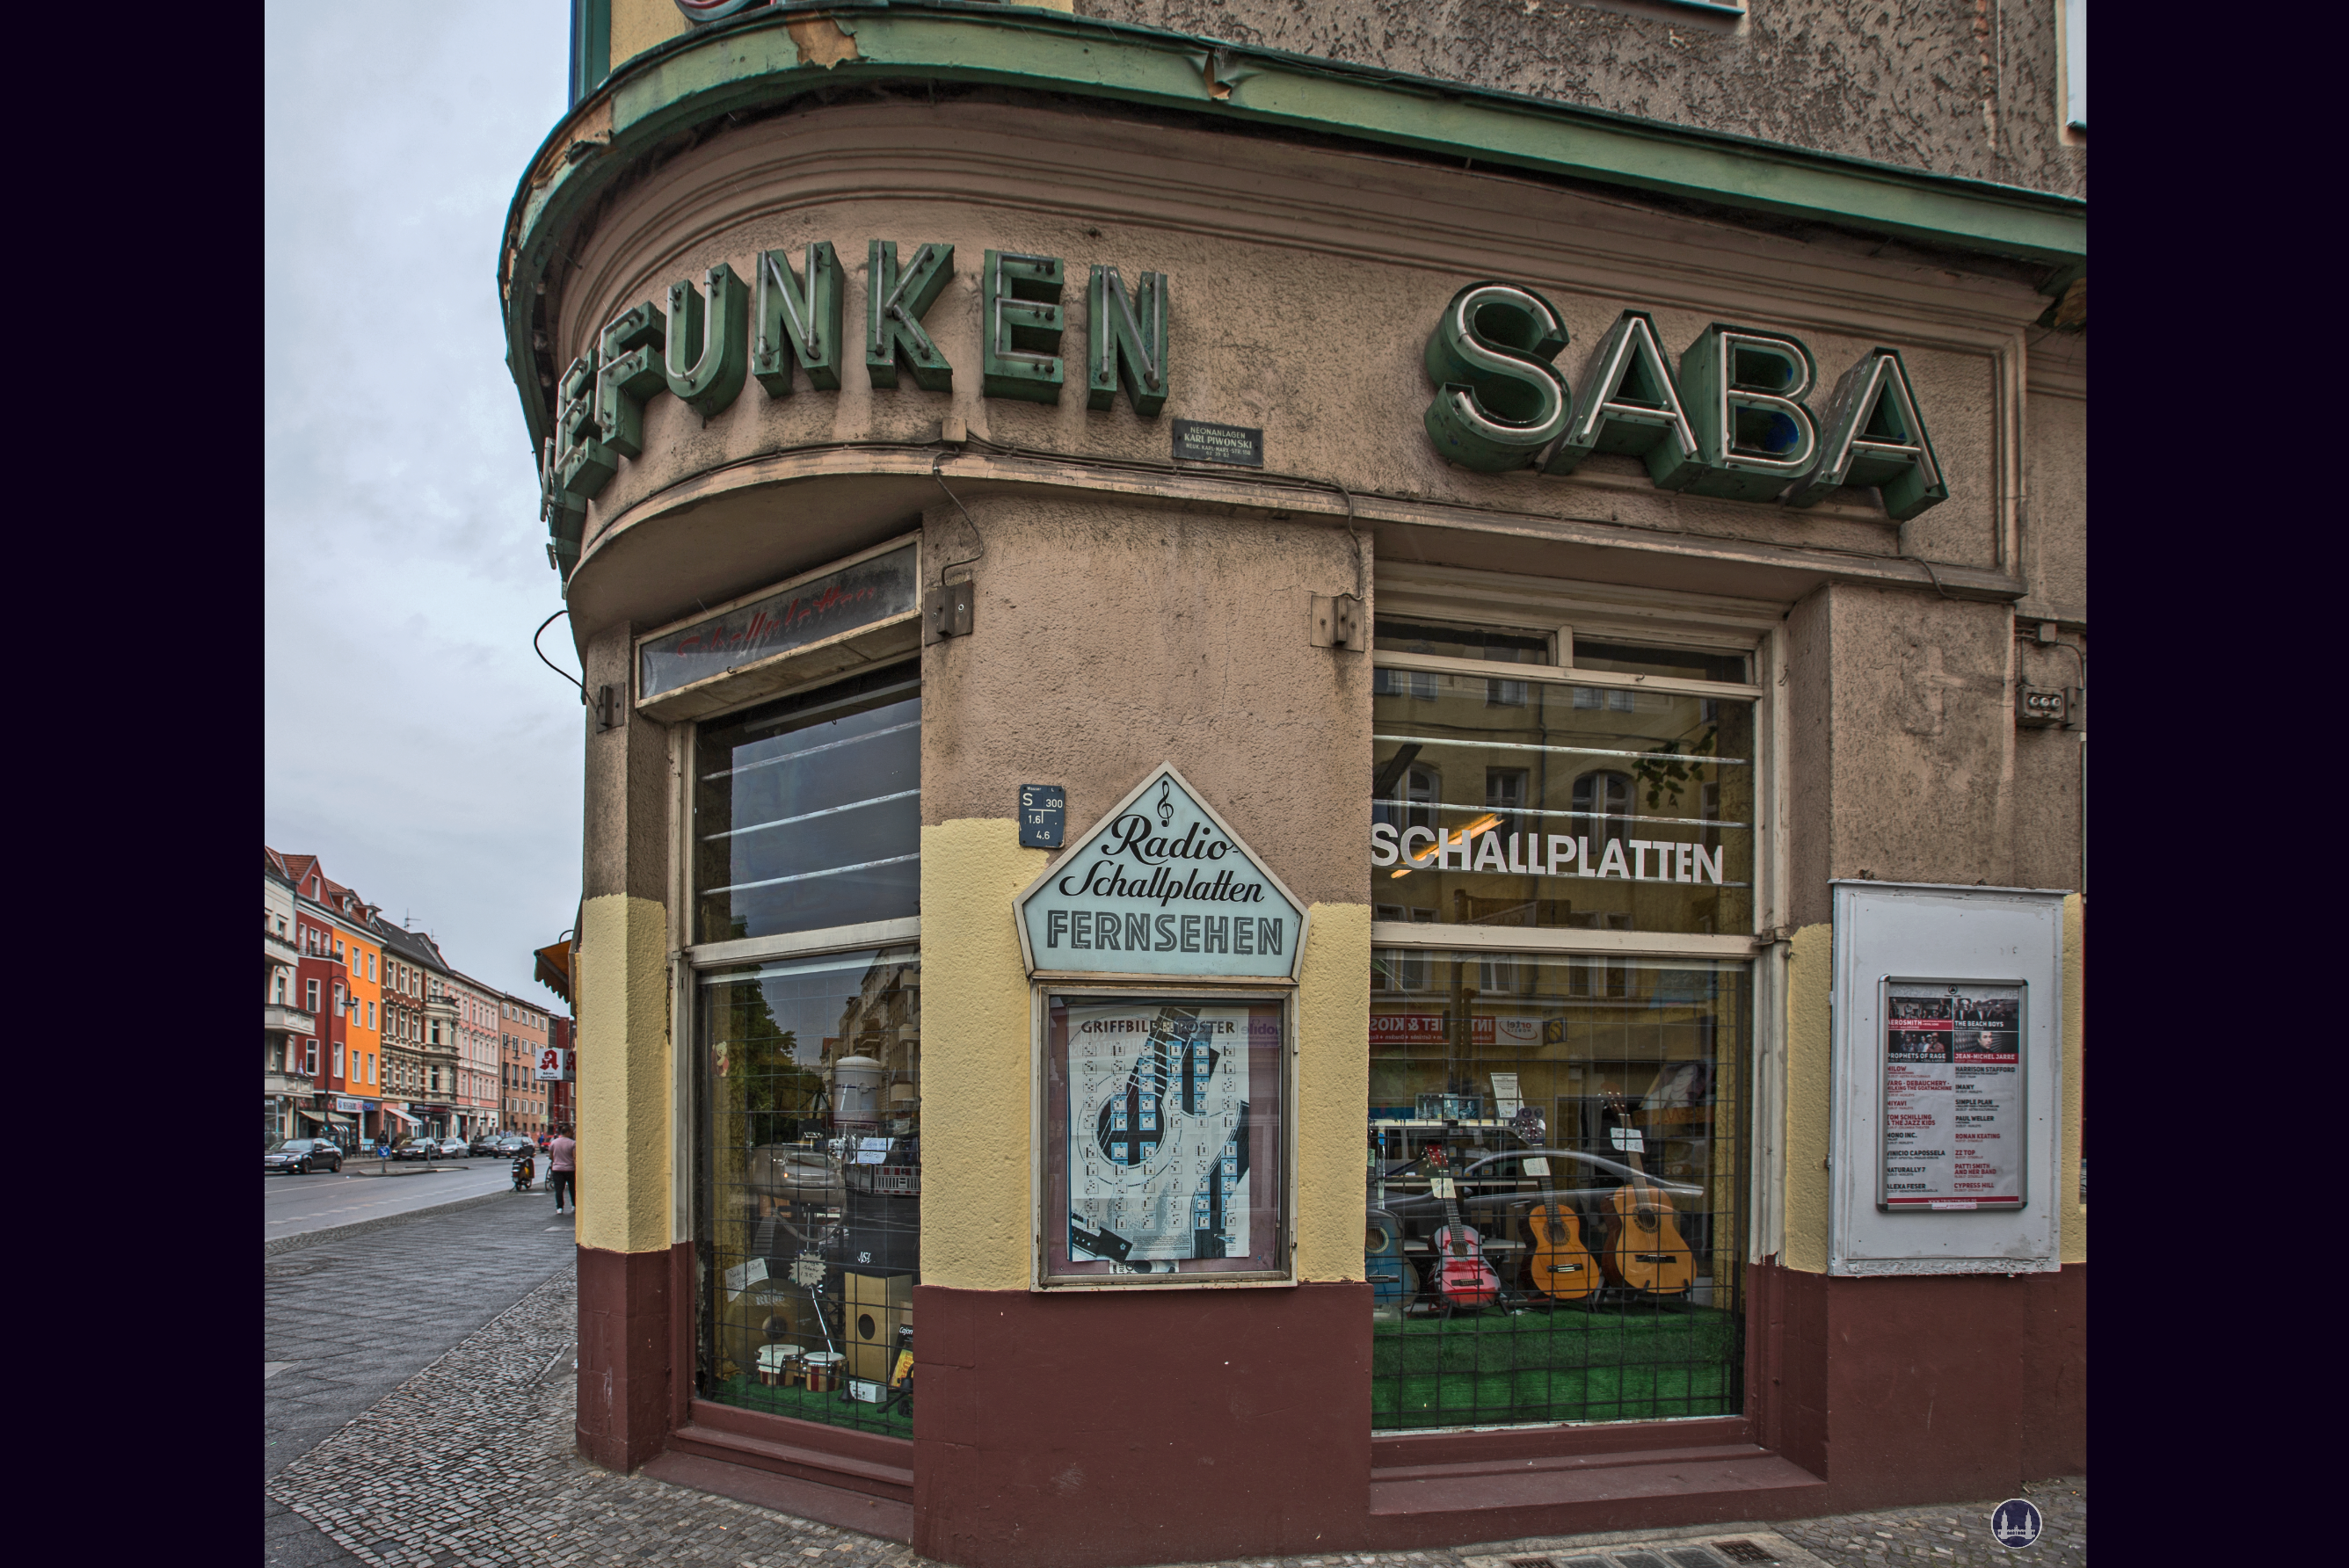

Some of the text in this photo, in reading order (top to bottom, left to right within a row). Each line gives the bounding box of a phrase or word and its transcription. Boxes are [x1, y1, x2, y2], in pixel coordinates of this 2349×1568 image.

[1424, 279, 1949, 521] SABA
[1190, 426, 1246, 439] NEONANLAGEN
[1184, 433, 1252, 449] KARL PIWONSKI
[1022, 792, 1063, 808] S 300
[1028, 814, 1041, 824] 1.6
[1036, 830, 1050, 840] 4.6
[1101, 814, 1239, 866] Radio-
[1371, 822, 1723, 885] SCHALLPLATTEN
[1058, 860, 1265, 907] Schallplatten
[1047, 909, 1284, 955] FERNSEHEN
[1081, 1020, 1235, 1034] GRIFFBILD POSTER
